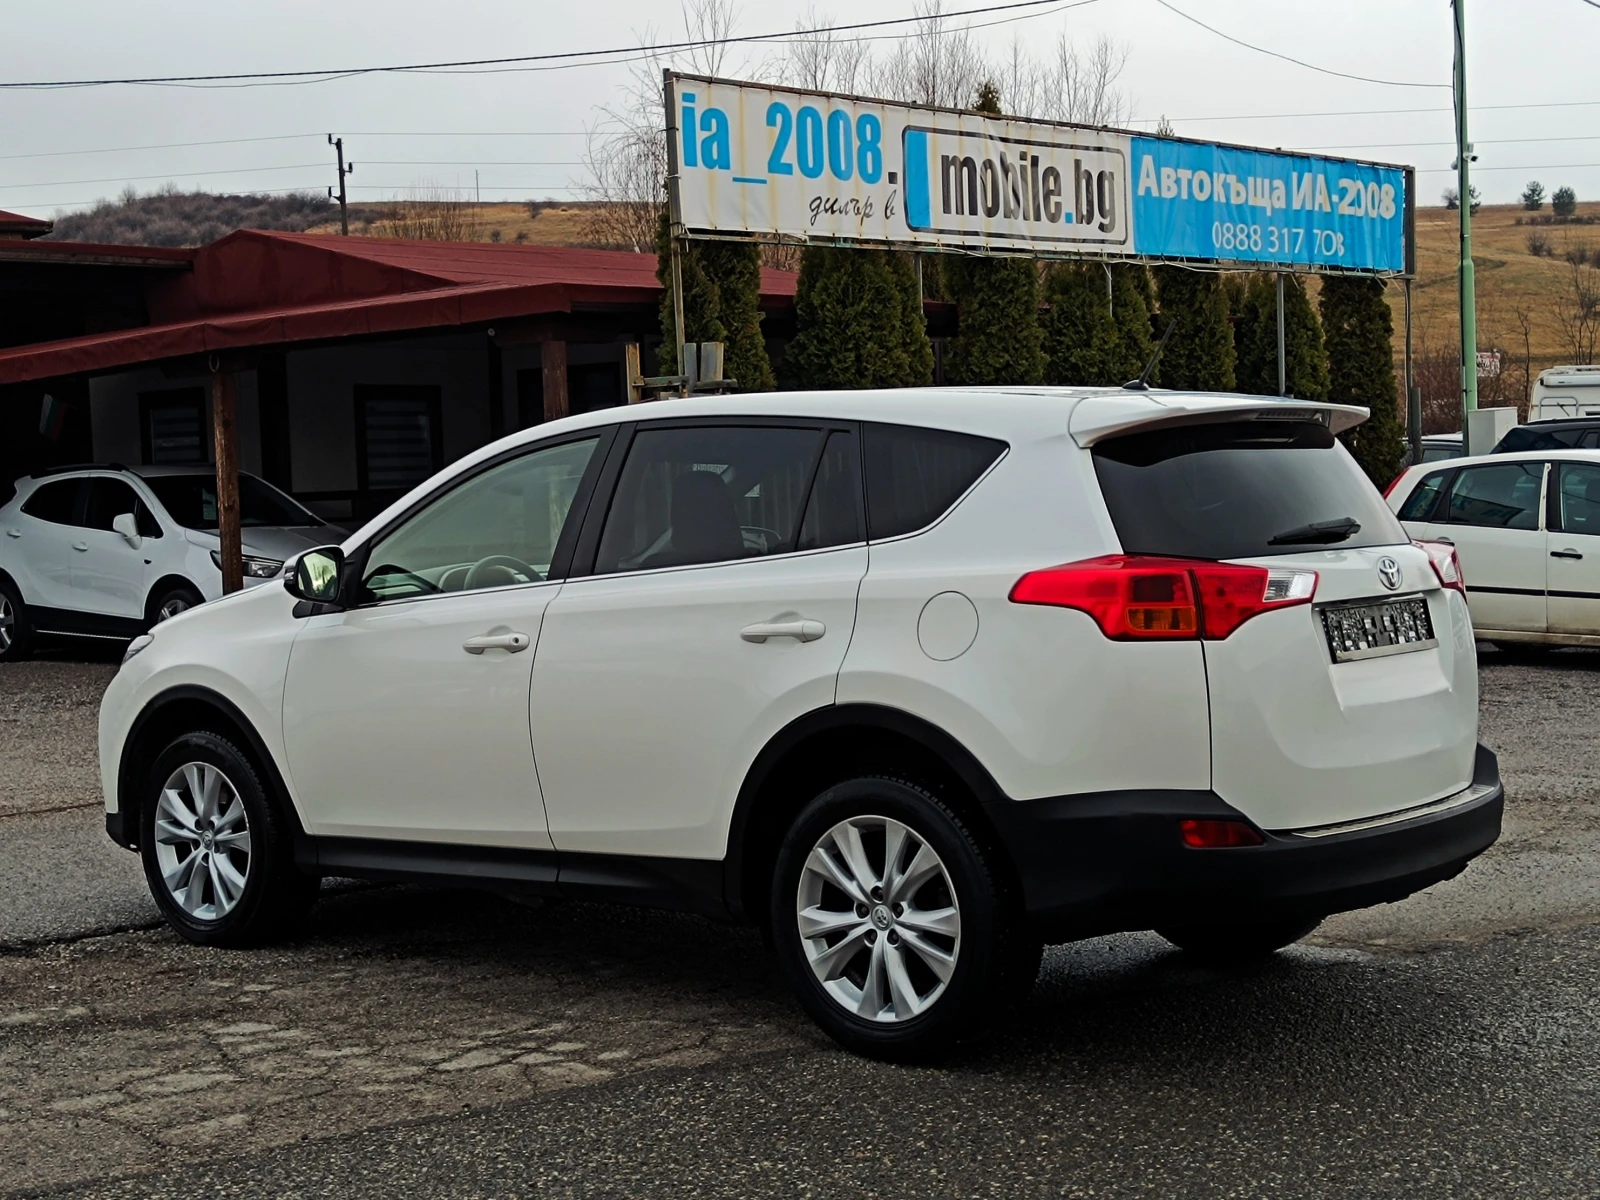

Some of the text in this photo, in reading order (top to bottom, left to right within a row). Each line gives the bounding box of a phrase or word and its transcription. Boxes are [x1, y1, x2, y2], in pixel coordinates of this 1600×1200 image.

[941, 150, 1116, 234] mobile.bg
[1137, 154, 1287, 217] Автокъща
[1211, 220, 1346, 257] 0888 317 708
